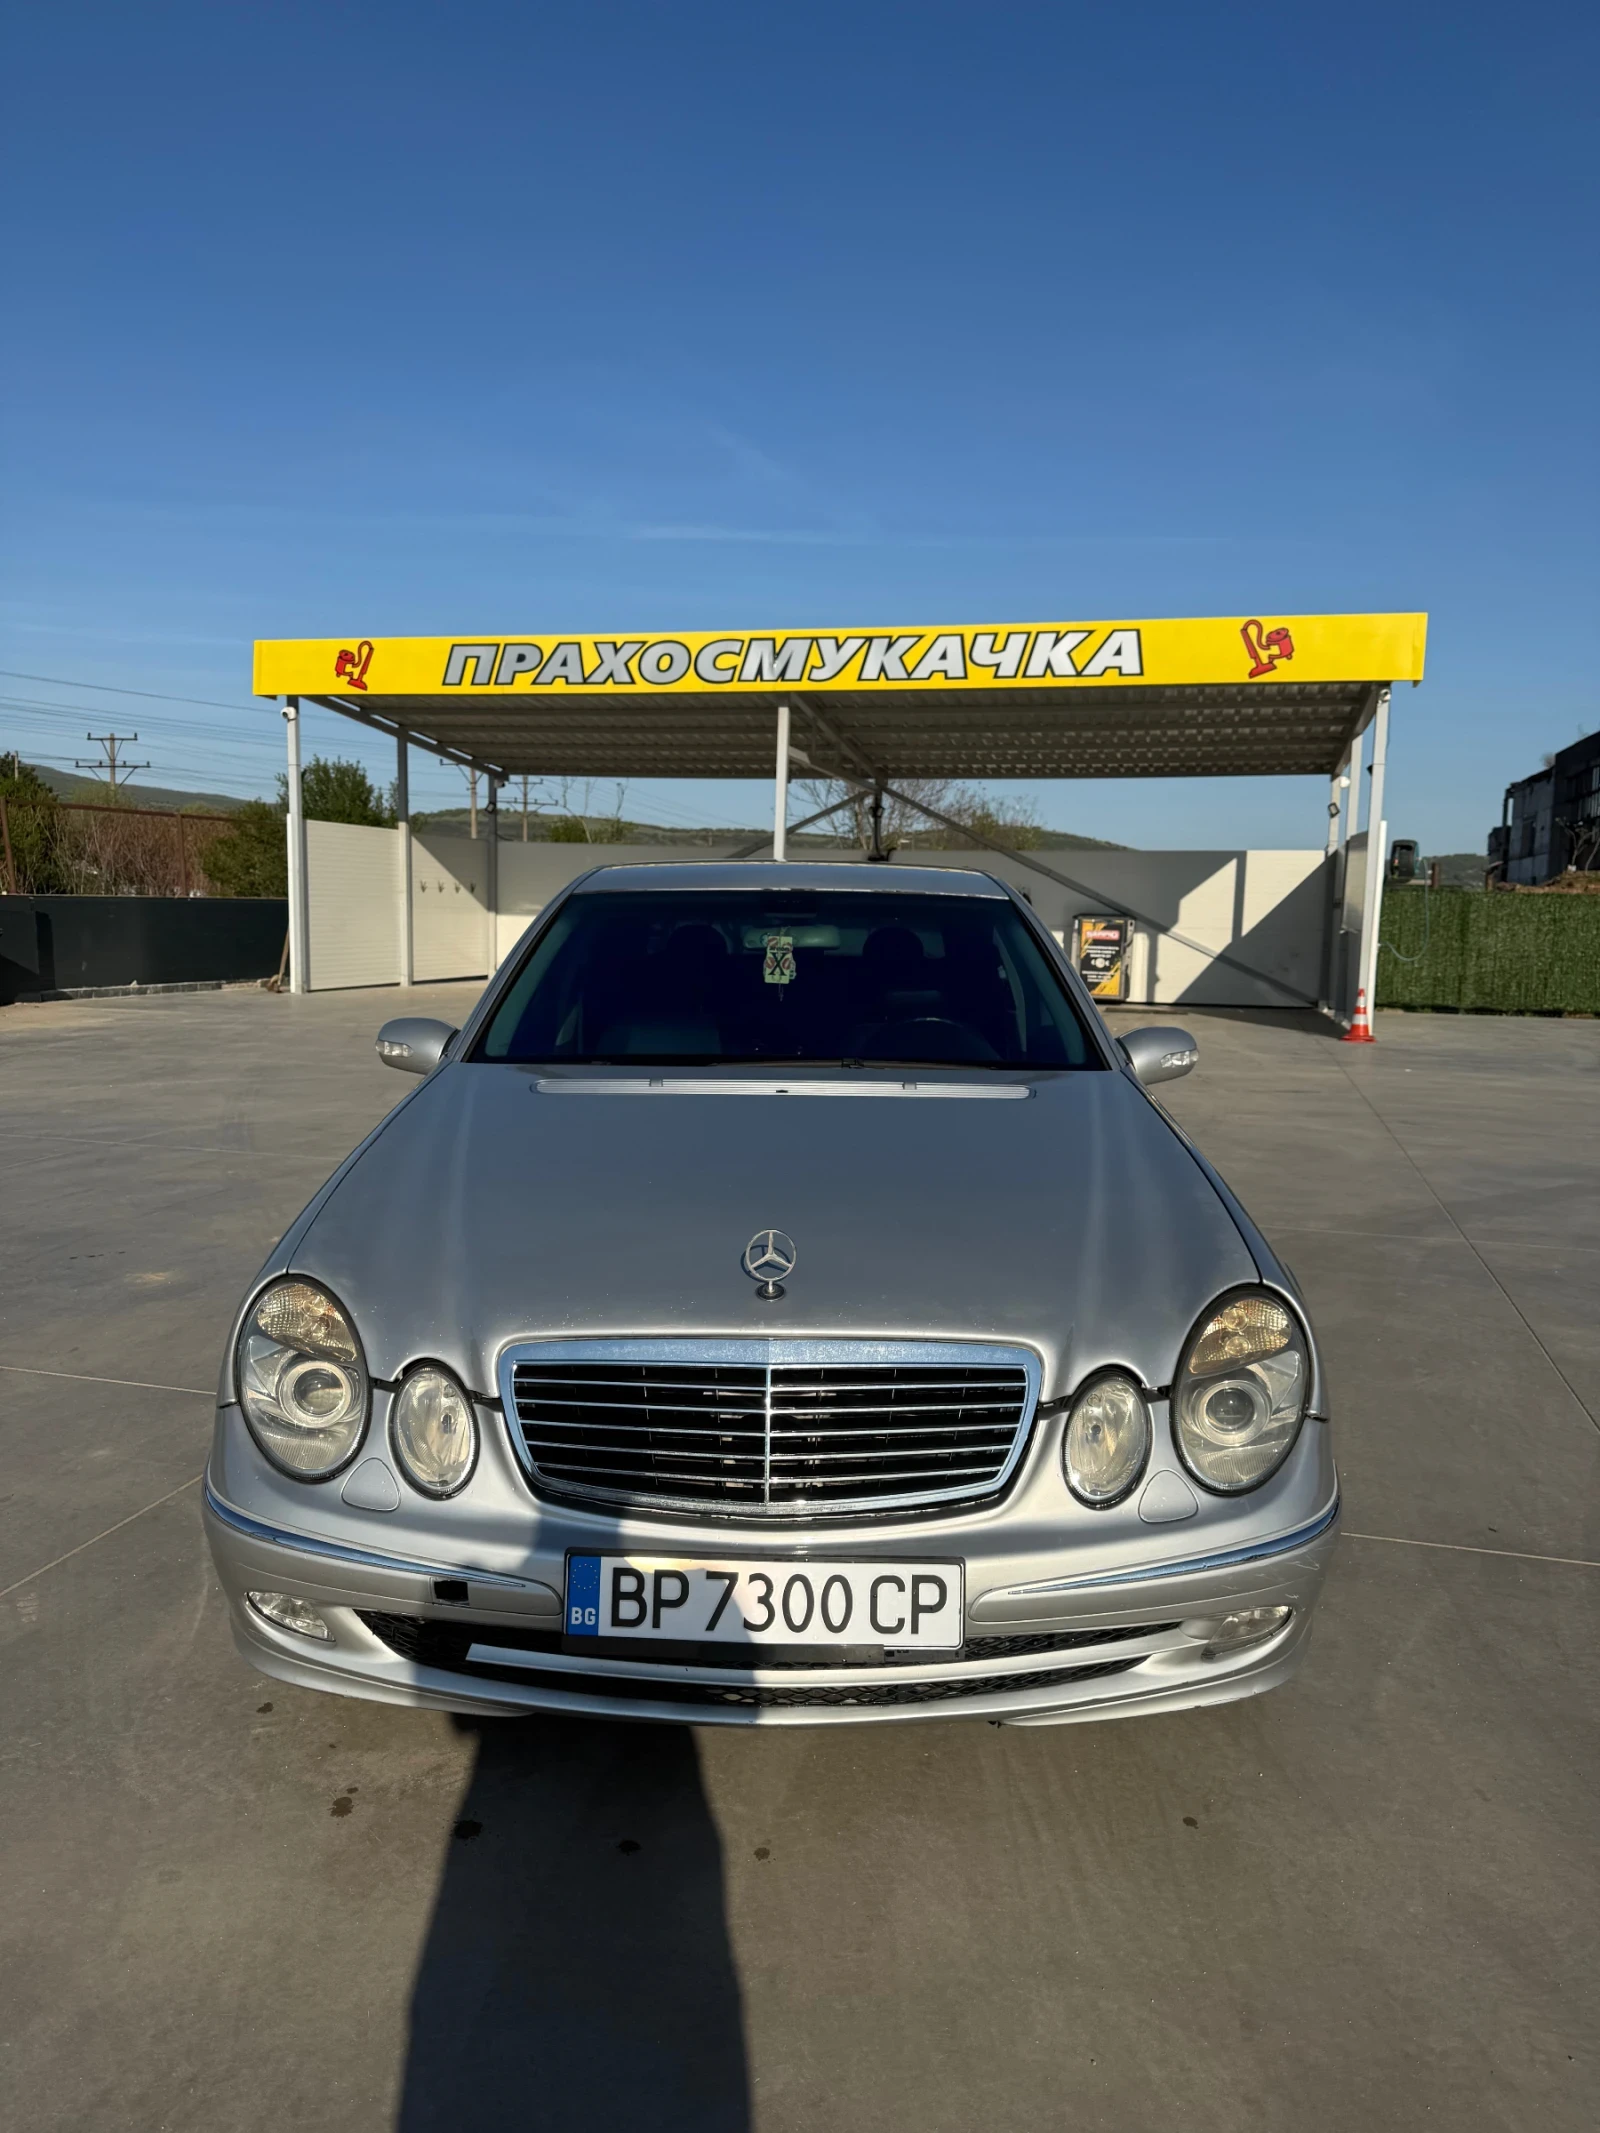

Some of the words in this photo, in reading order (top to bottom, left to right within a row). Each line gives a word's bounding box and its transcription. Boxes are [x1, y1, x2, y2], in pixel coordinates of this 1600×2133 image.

[443, 630, 1143, 685] ПРАХОСМУКАЧКА
[571, 1606, 597, 1627] BG
[705, 1571, 853, 1634] 7300
